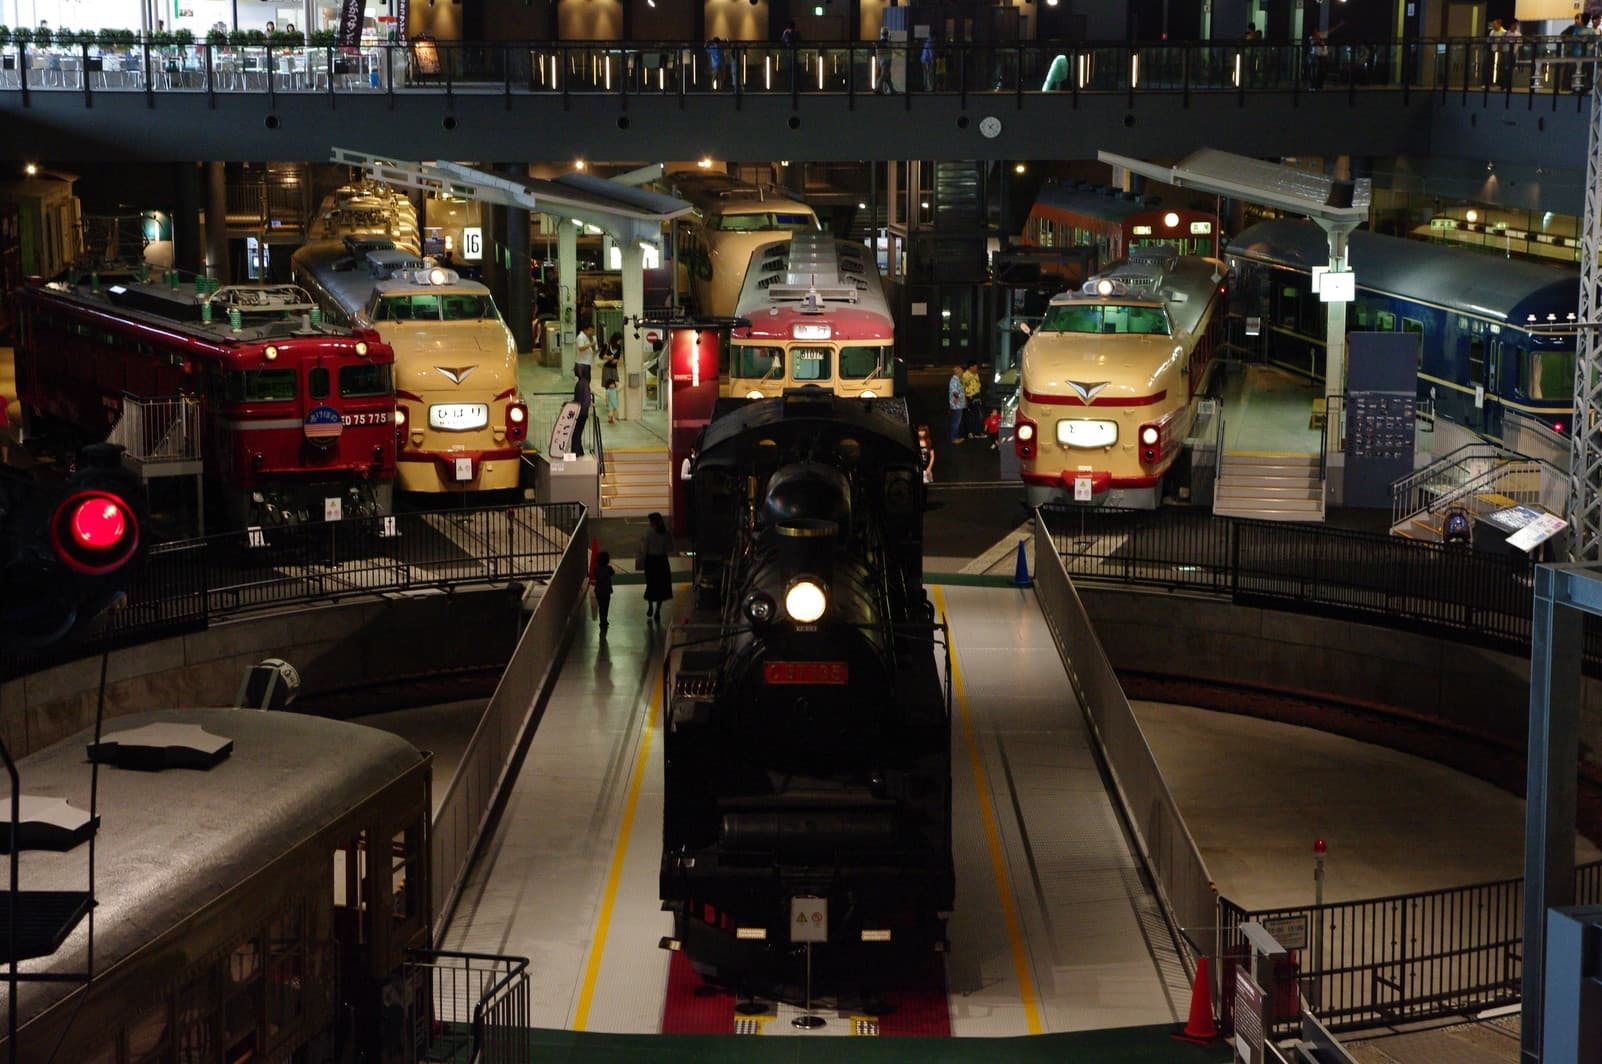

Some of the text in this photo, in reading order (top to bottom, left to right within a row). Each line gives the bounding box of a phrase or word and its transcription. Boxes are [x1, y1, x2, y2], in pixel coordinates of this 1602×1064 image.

[467, 234, 479, 253] 16
[354, 414, 366, 425] 75
[368, 412, 387, 424] 775
